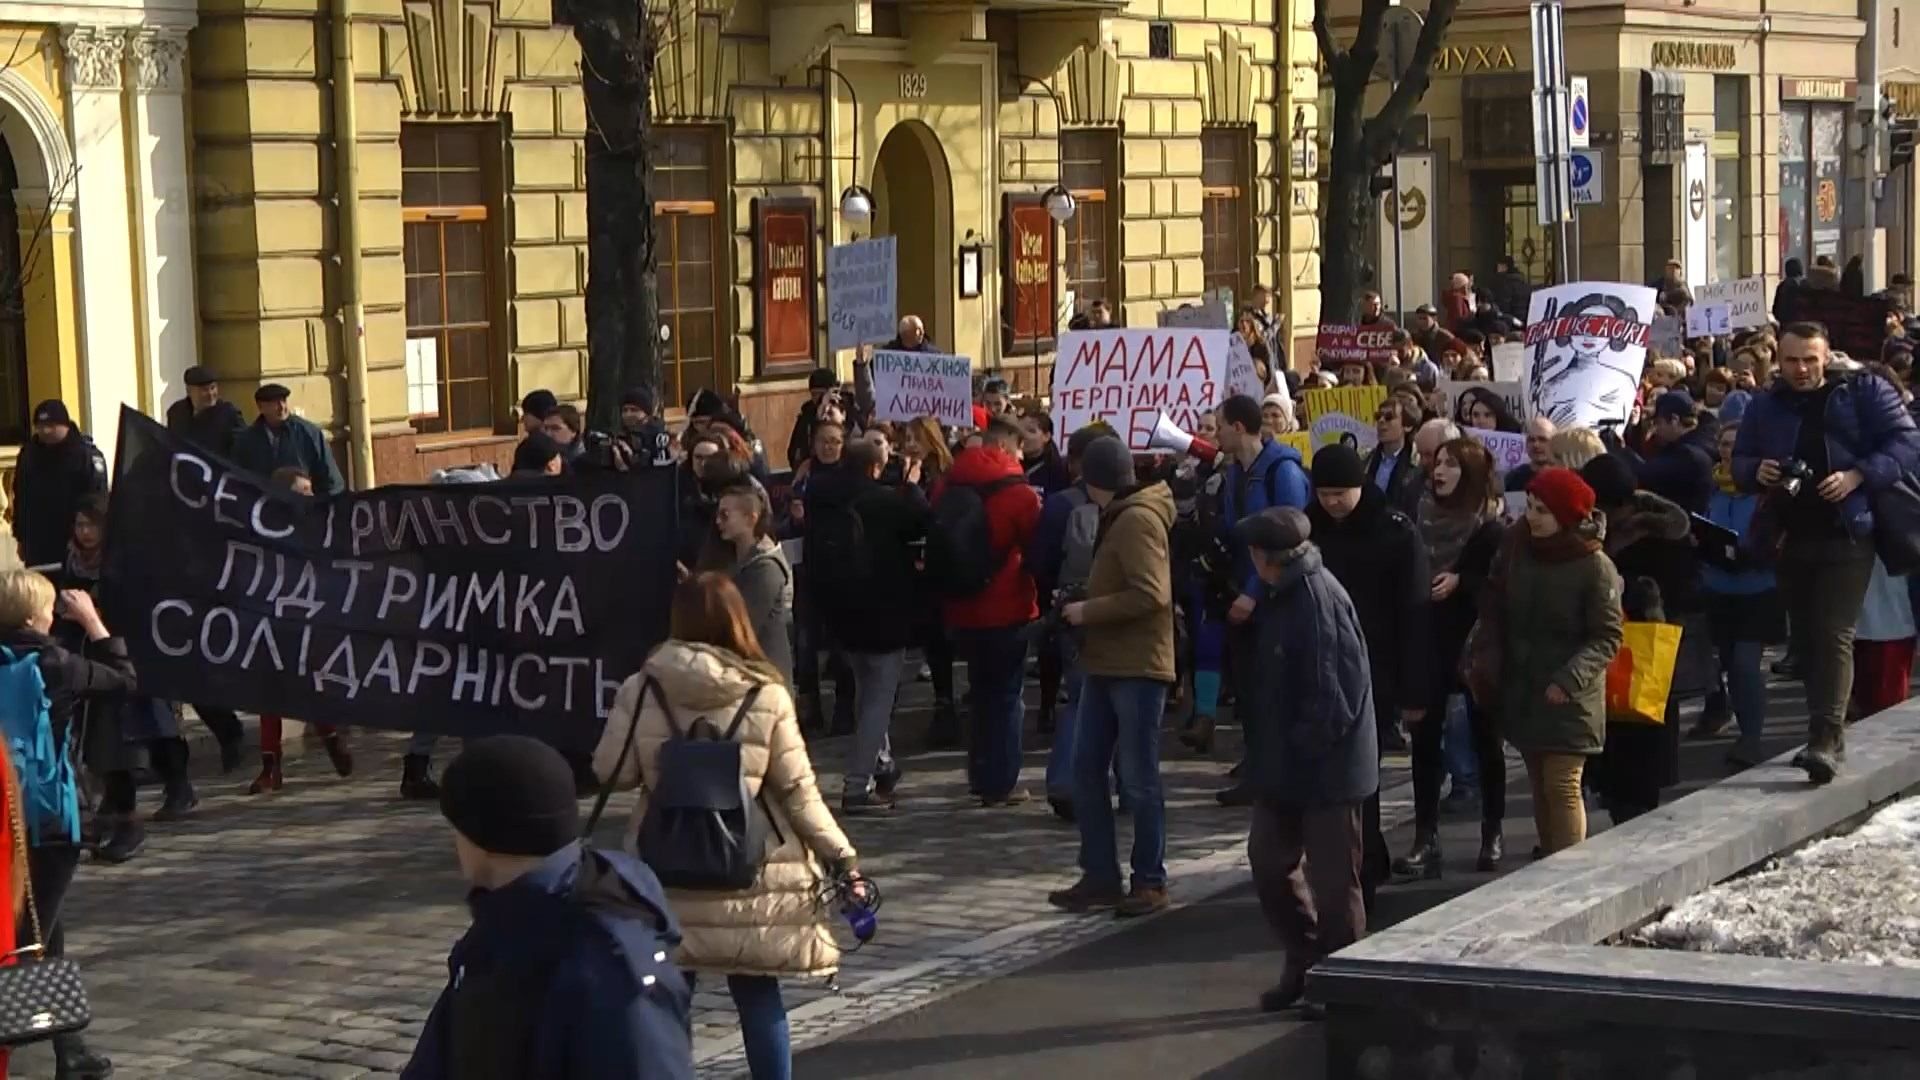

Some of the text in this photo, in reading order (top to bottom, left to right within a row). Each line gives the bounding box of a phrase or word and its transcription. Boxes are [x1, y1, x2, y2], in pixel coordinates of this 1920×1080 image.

[900, 73, 928, 98] 1829
[1356, 331, 1393, 348] СЕБЕ
[1597, 319, 1610, 337] A
[875, 353, 970, 377] ПРАВА ЖІНОК
[1065, 335, 1210, 384] МАМА
[901, 374, 945, 392] ПРАВА
[1176, 383, 1191, 407] А
[1197, 381, 1215, 407] Я
[889, 393, 966, 420] ЛЮДИНИ
[217, 541, 586, 636] ПІДТРИМКА
[151, 599, 622, 719] СОЛІДАРНІСТЬ
